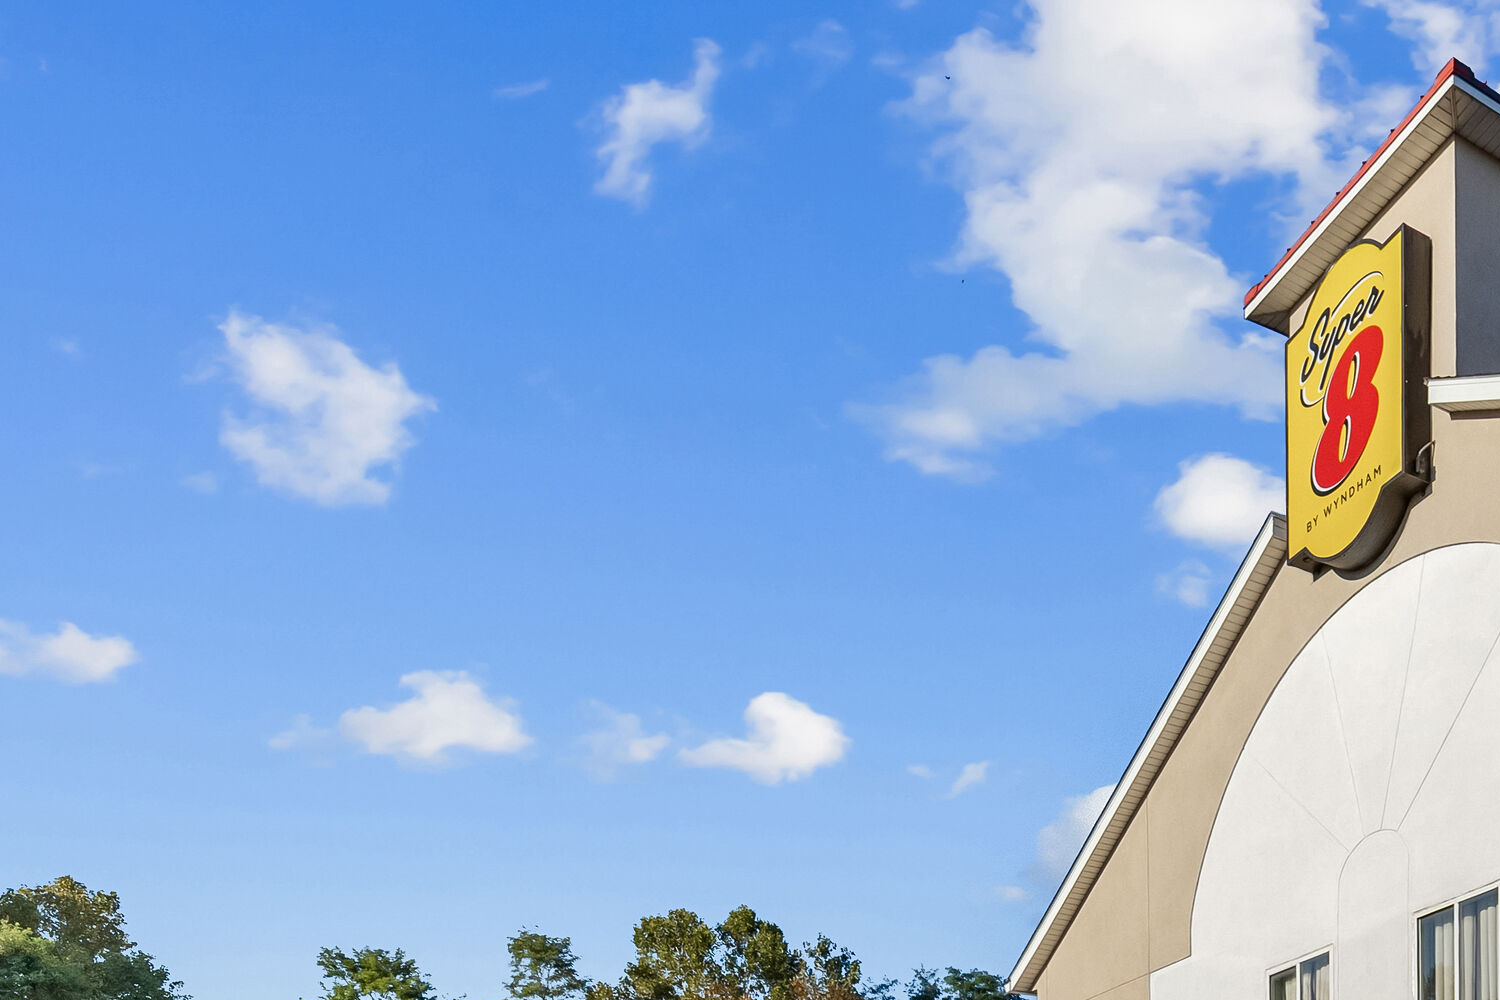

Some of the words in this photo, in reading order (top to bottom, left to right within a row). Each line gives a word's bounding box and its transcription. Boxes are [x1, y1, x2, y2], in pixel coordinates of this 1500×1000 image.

[1300, 271, 1384, 393] Super
[1311, 325, 1384, 497] 8
[1306, 515, 1319, 533] BY
[1323, 464, 1382, 518] WYNDHAM
